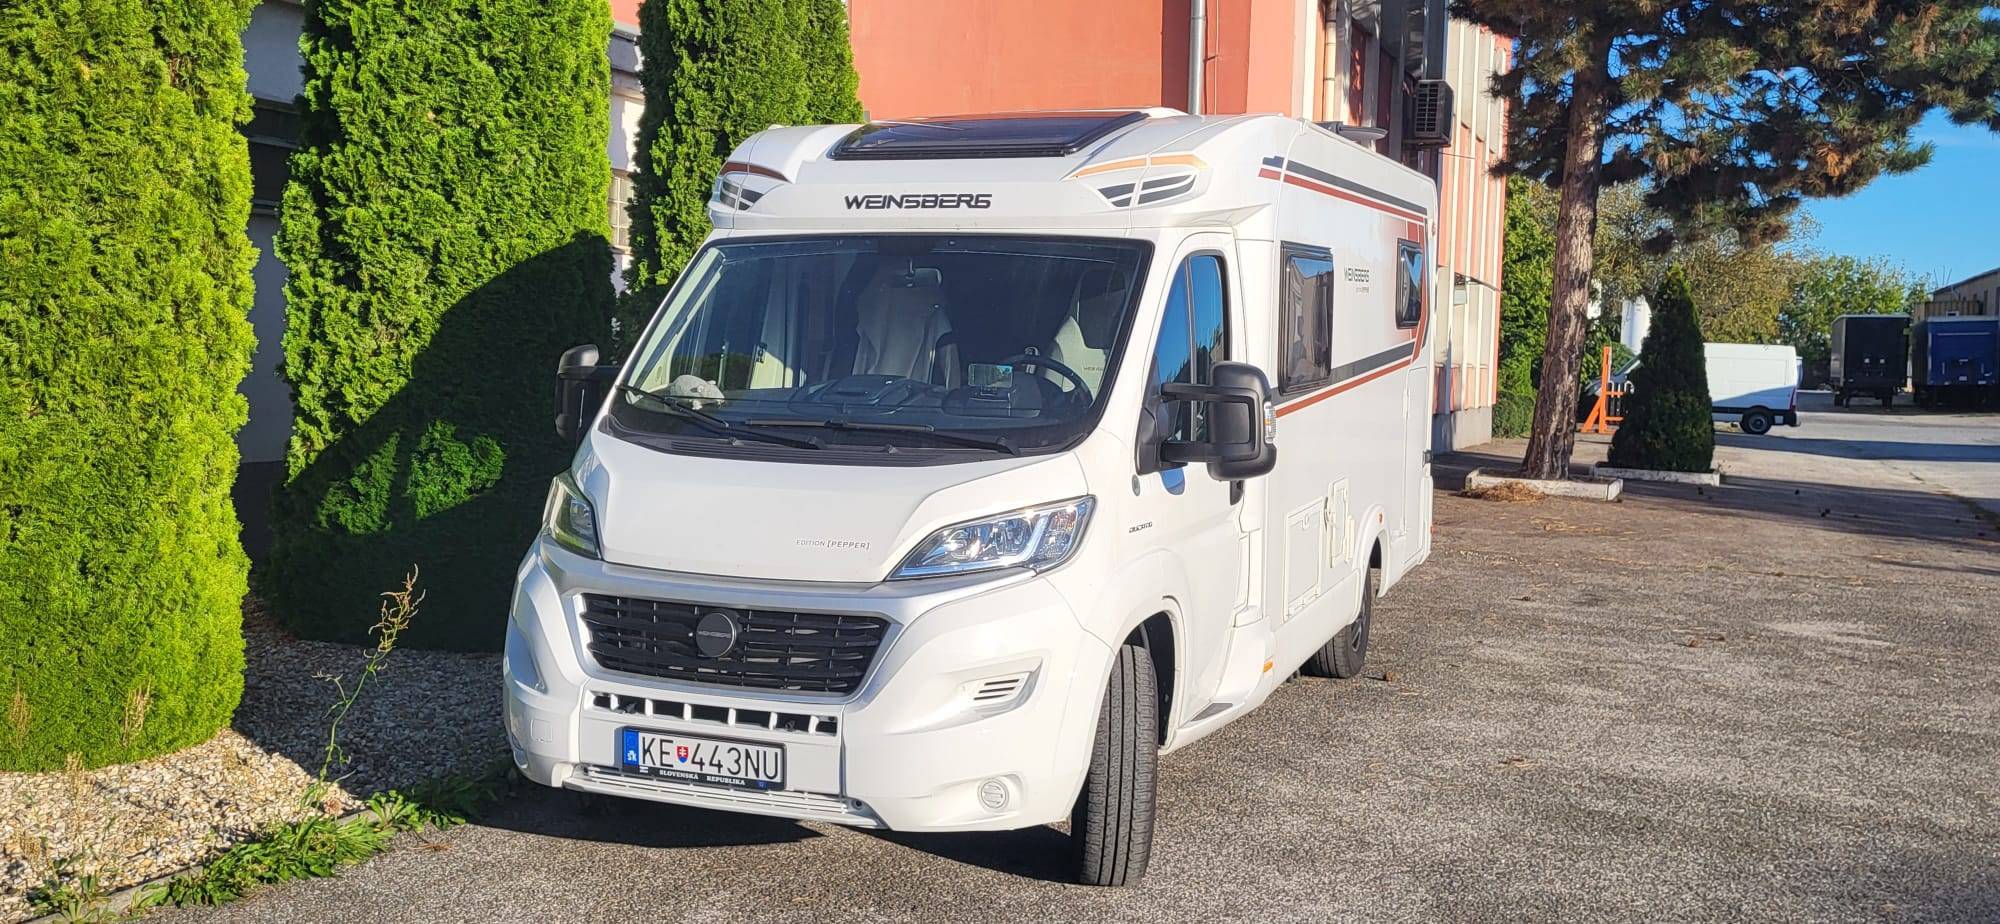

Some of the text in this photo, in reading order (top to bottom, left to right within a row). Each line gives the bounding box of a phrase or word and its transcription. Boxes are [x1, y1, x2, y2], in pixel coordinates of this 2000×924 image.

[844, 193, 993, 210] WEINSBERG
[796, 539, 826, 547] EDITION
[641, 736, 779, 780] KE 443NU
[659, 769, 746, 786] SLOVENSKÁ REPUBLIKA
